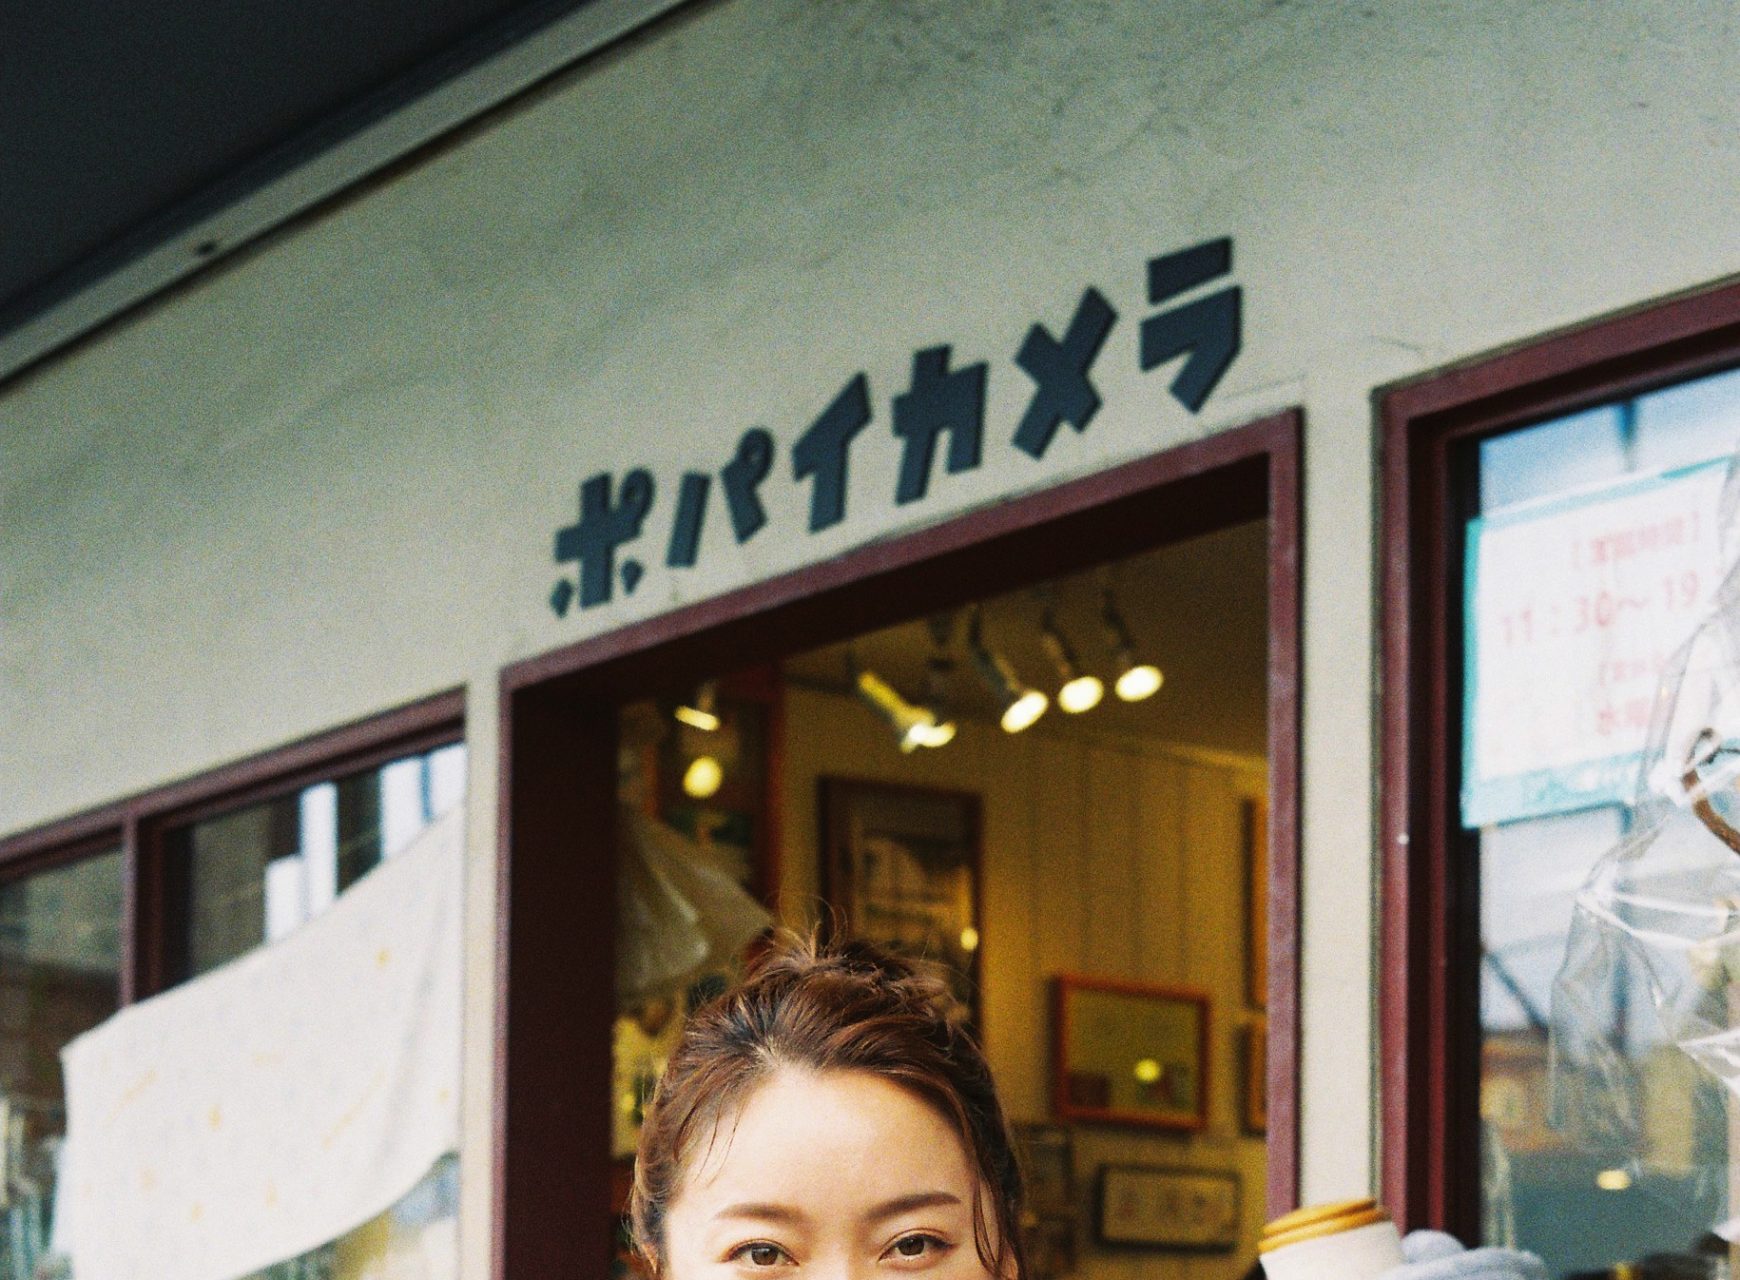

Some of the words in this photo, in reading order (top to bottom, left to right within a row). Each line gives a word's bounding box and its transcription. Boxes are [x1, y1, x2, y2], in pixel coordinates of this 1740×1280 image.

[550, 236, 1243, 619] ポパイカメラ
